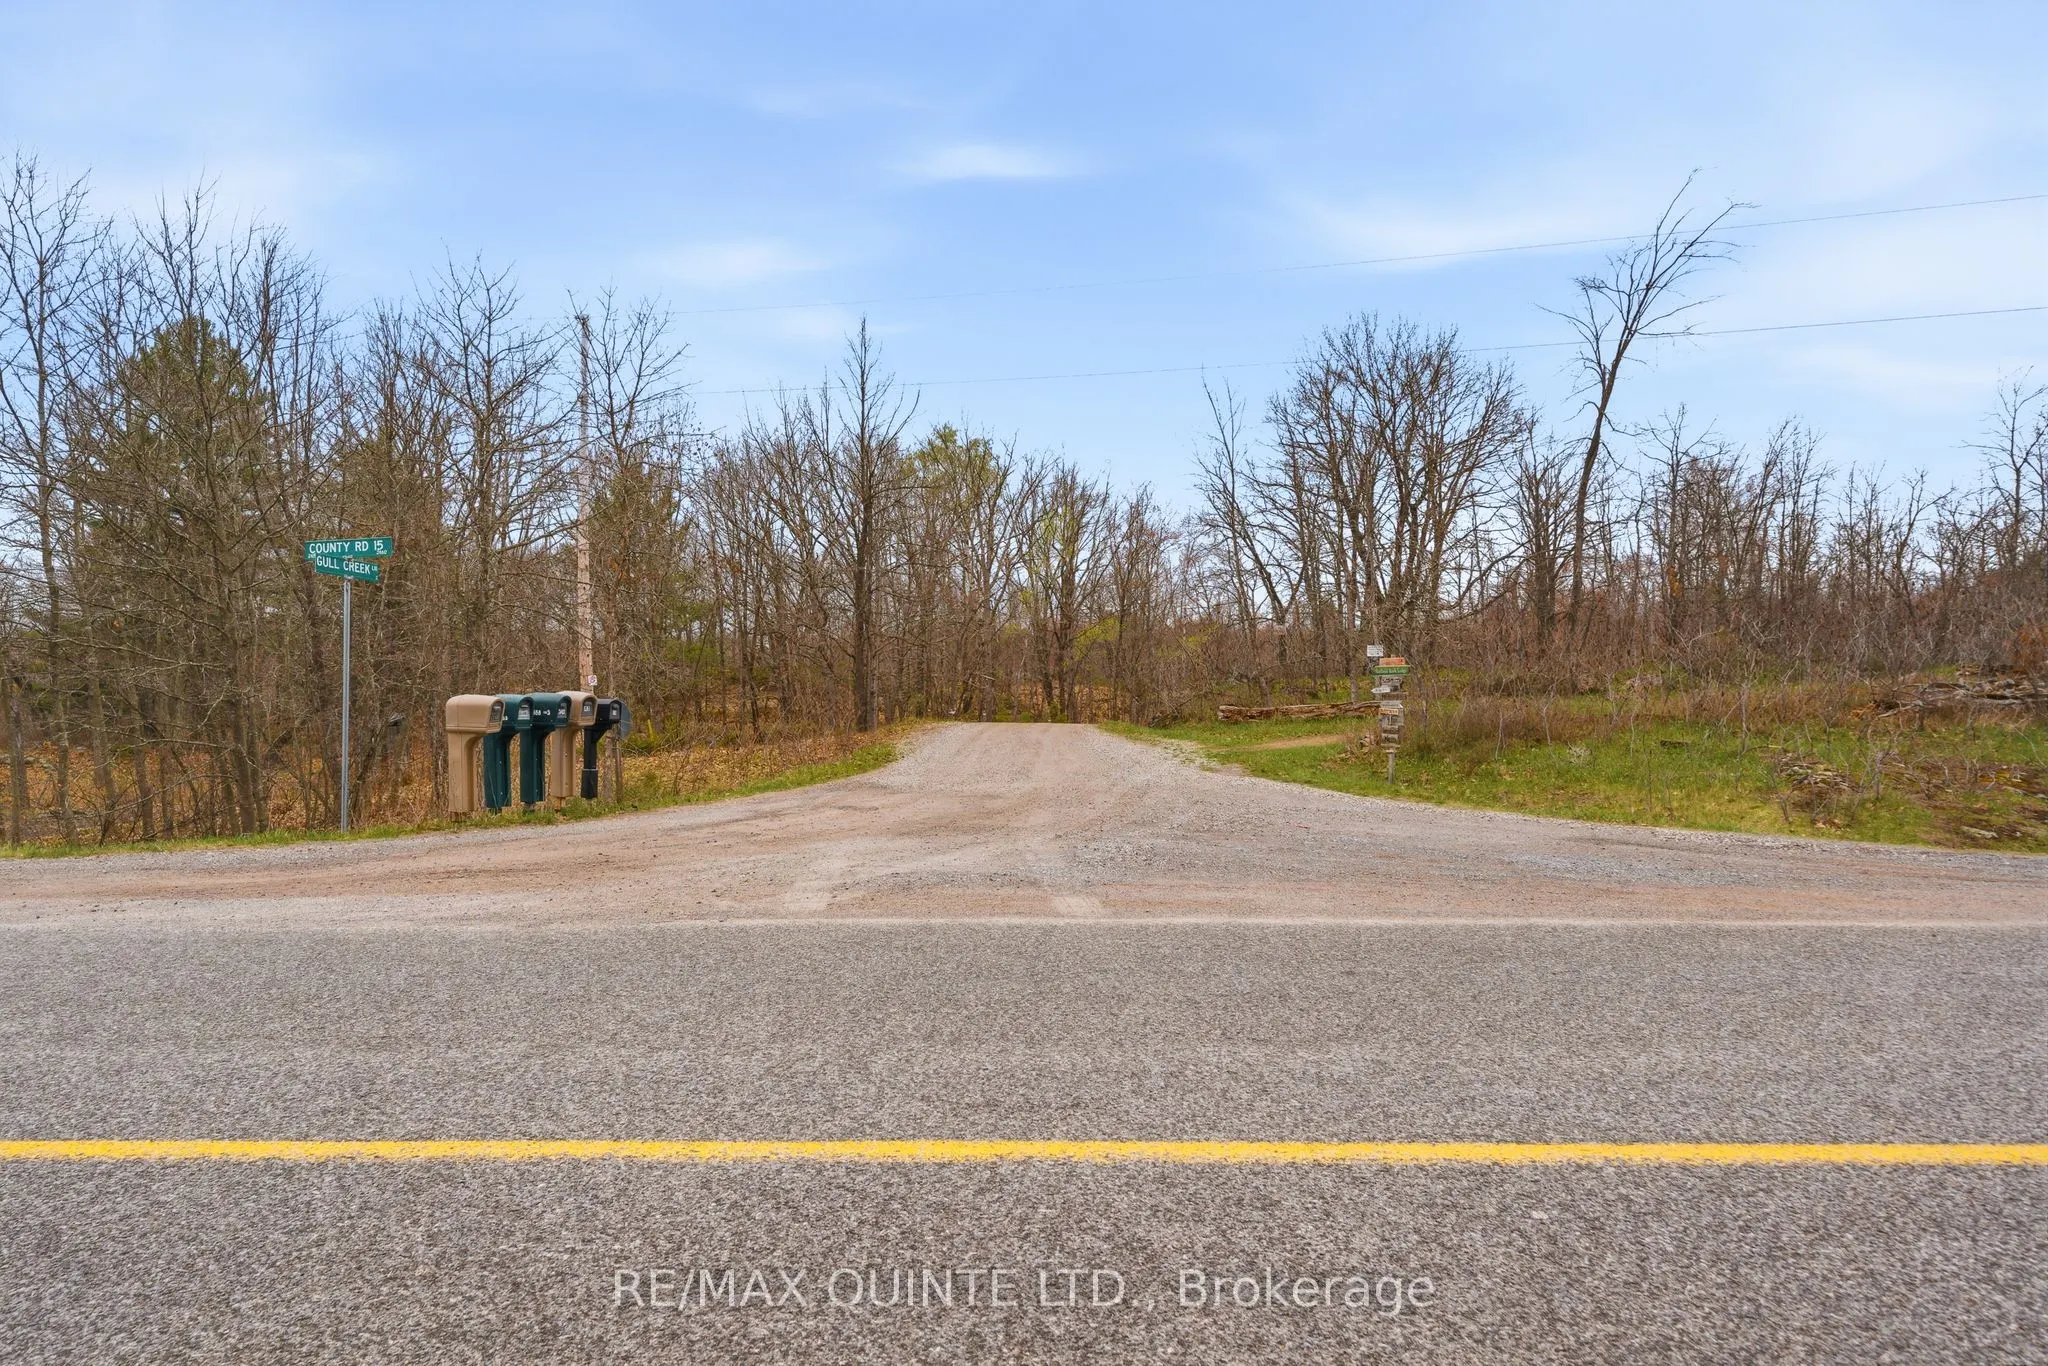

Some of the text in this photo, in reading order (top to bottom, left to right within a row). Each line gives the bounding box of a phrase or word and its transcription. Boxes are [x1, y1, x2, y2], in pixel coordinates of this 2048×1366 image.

[309, 540, 384, 554] COUNTY RD 15
[316, 555, 340, 570] GULL
[343, 560, 371, 575] CREEK
